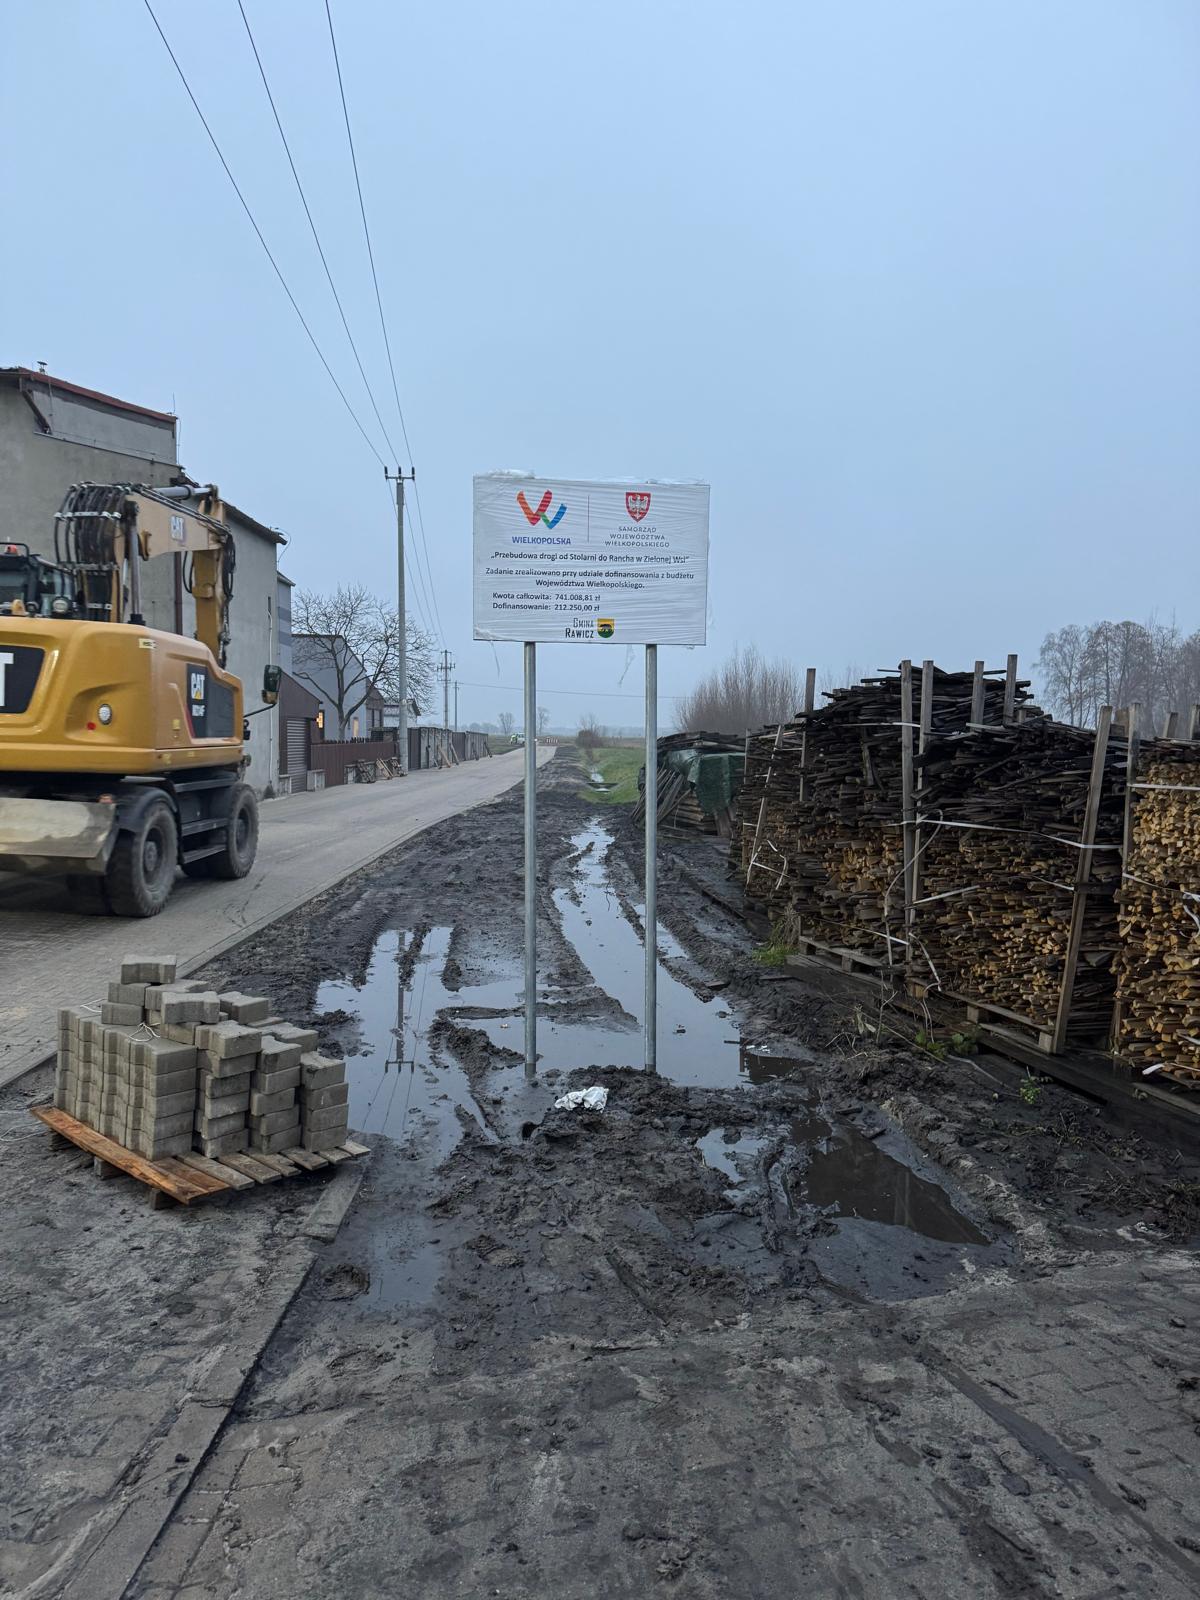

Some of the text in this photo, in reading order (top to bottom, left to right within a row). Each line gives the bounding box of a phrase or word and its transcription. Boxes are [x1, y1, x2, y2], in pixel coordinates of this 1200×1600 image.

[618, 526, 657, 534] SAMORZĄD
[511, 536, 572, 545] WIELKOPOLSKA
[539, 552, 558, 561] drogi
[570, 553, 597, 561] Stolarni
[598, 554, 608, 562] do
[609, 554, 635, 562] Rancha
[643, 555, 672, 564] Zielonej
[485, 567, 514, 575] Zadanie
[515, 568, 561, 576] zrealizowano
[578, 570, 603, 578] udziale
[604, 570, 660, 579] dofinansowania
[666, 572, 694, 580] budżetu
[535, 579, 645, 590] Województwa Wielkopolskiego.
[492, 592, 515, 600] Kwota
[516, 592, 552, 600] całkowita:
[555, 593, 593, 601] 741.008,81
[492, 602, 600, 612] Dofinansowanie: 212.250,00 zł
